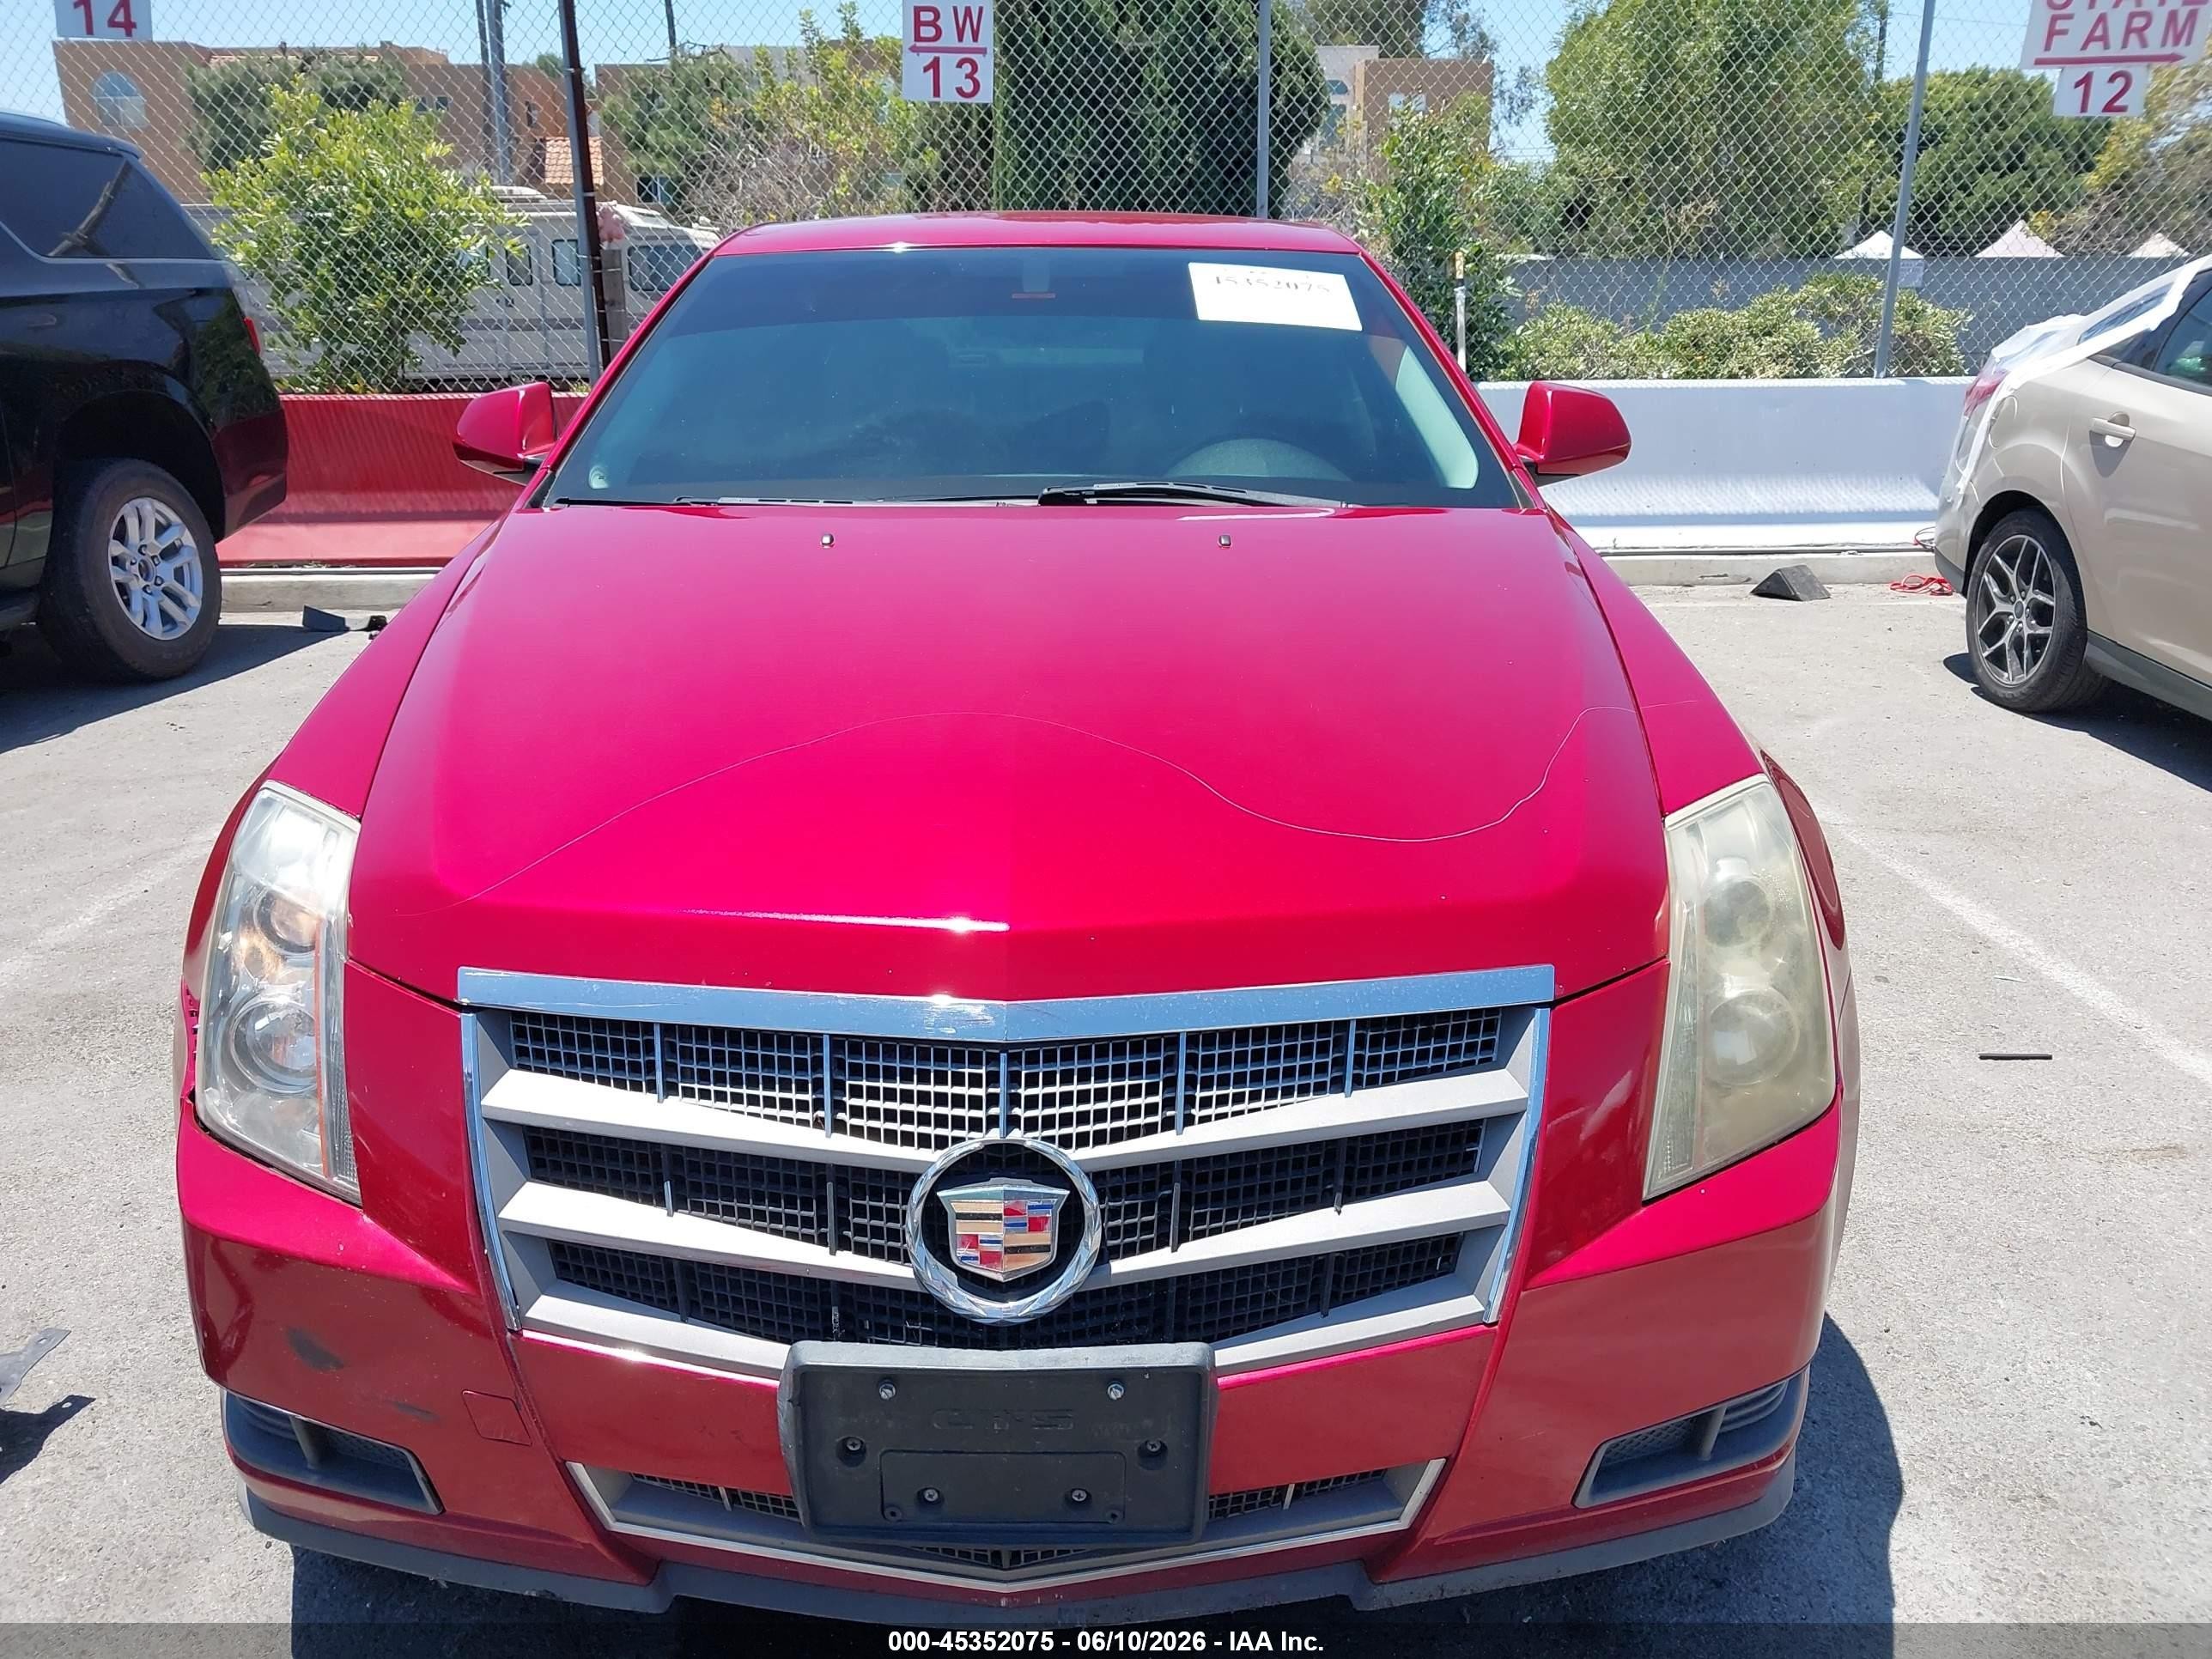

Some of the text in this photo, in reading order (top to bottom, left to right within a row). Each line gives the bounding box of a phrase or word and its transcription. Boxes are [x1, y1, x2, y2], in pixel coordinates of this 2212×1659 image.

[73, 0, 137, 37] 14
[913, 5, 984, 43] BW
[2044, 8, 2200, 52] FARM
[922, 56, 981, 99] 13
[2074, 70, 2133, 113] 12
